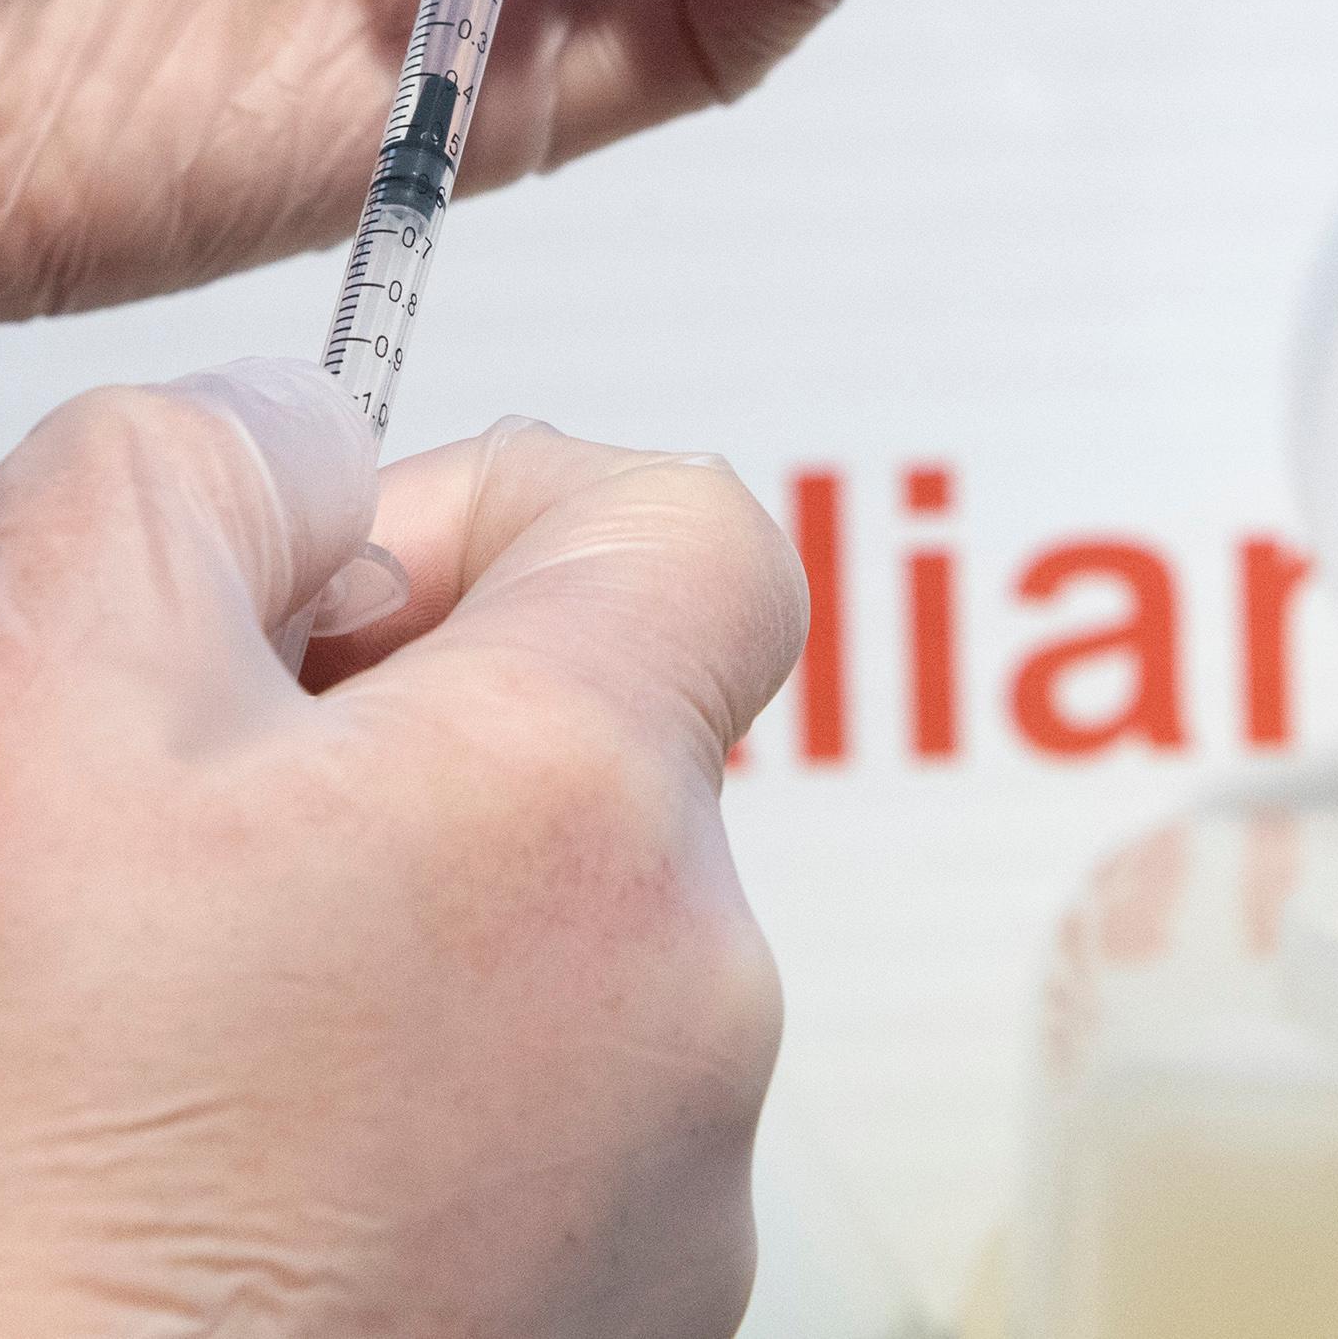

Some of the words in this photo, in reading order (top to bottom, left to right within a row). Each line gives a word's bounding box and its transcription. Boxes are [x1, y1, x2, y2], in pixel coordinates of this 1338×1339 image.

[457, 18, 488, 54] 0.3
[444, 69, 475, 105] 0.4
[401, 225, 433, 260] 0.7
[388, 279, 418, 317] 0.8
[374, 334, 404, 373] 0.9
